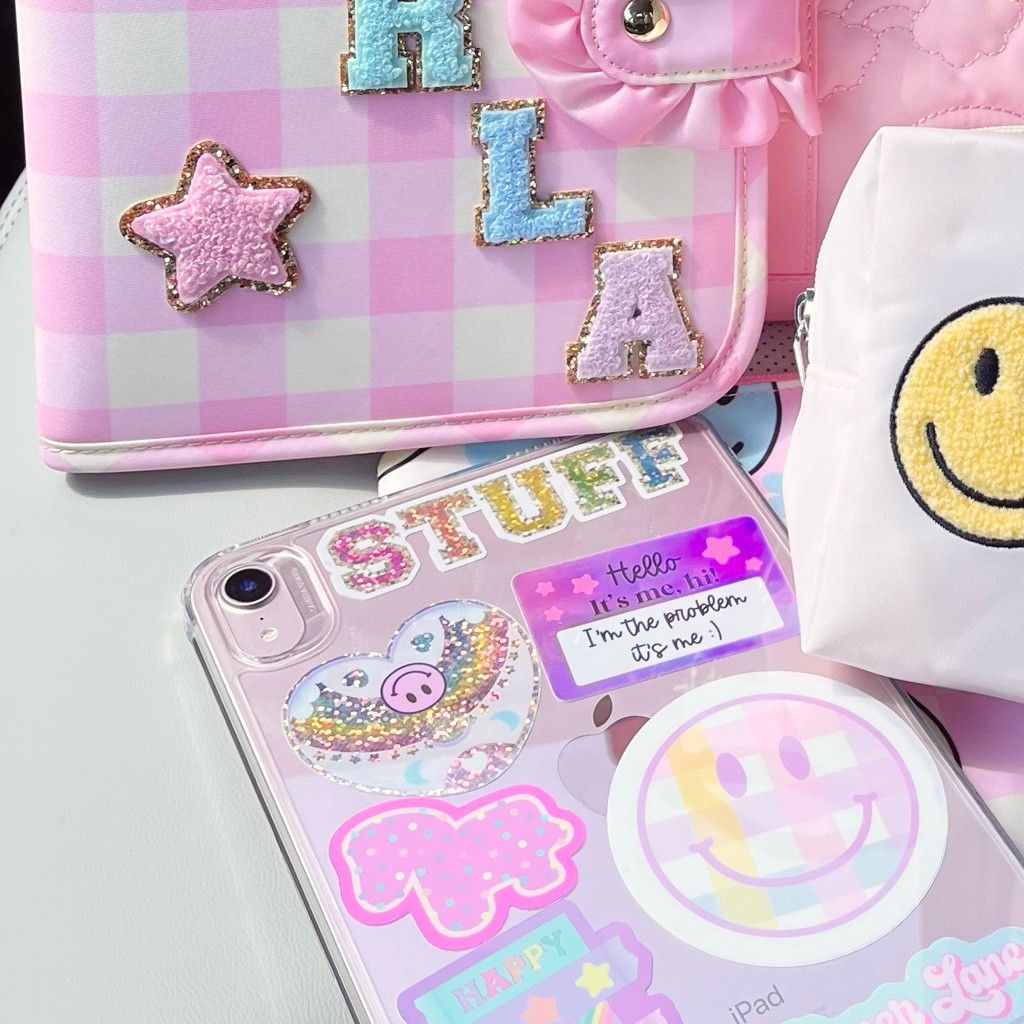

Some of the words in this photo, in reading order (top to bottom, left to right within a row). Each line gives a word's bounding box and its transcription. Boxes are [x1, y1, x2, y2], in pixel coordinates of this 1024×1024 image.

[326, 423, 684, 596] STUFF
[589, 587, 629, 616] It's
[637, 581, 681, 604] me,
[686, 568, 720, 591] hi!
[606, 552, 681, 586] Hello
[582, 626, 622, 648] I'm
[621, 616, 659, 637] the
[664, 594, 747, 628] problem
[631, 640, 667, 663] it's
[672, 630, 703, 651] me
[451, 929, 568, 1014] HAPPY
[728, 984, 785, 1024] iPad
